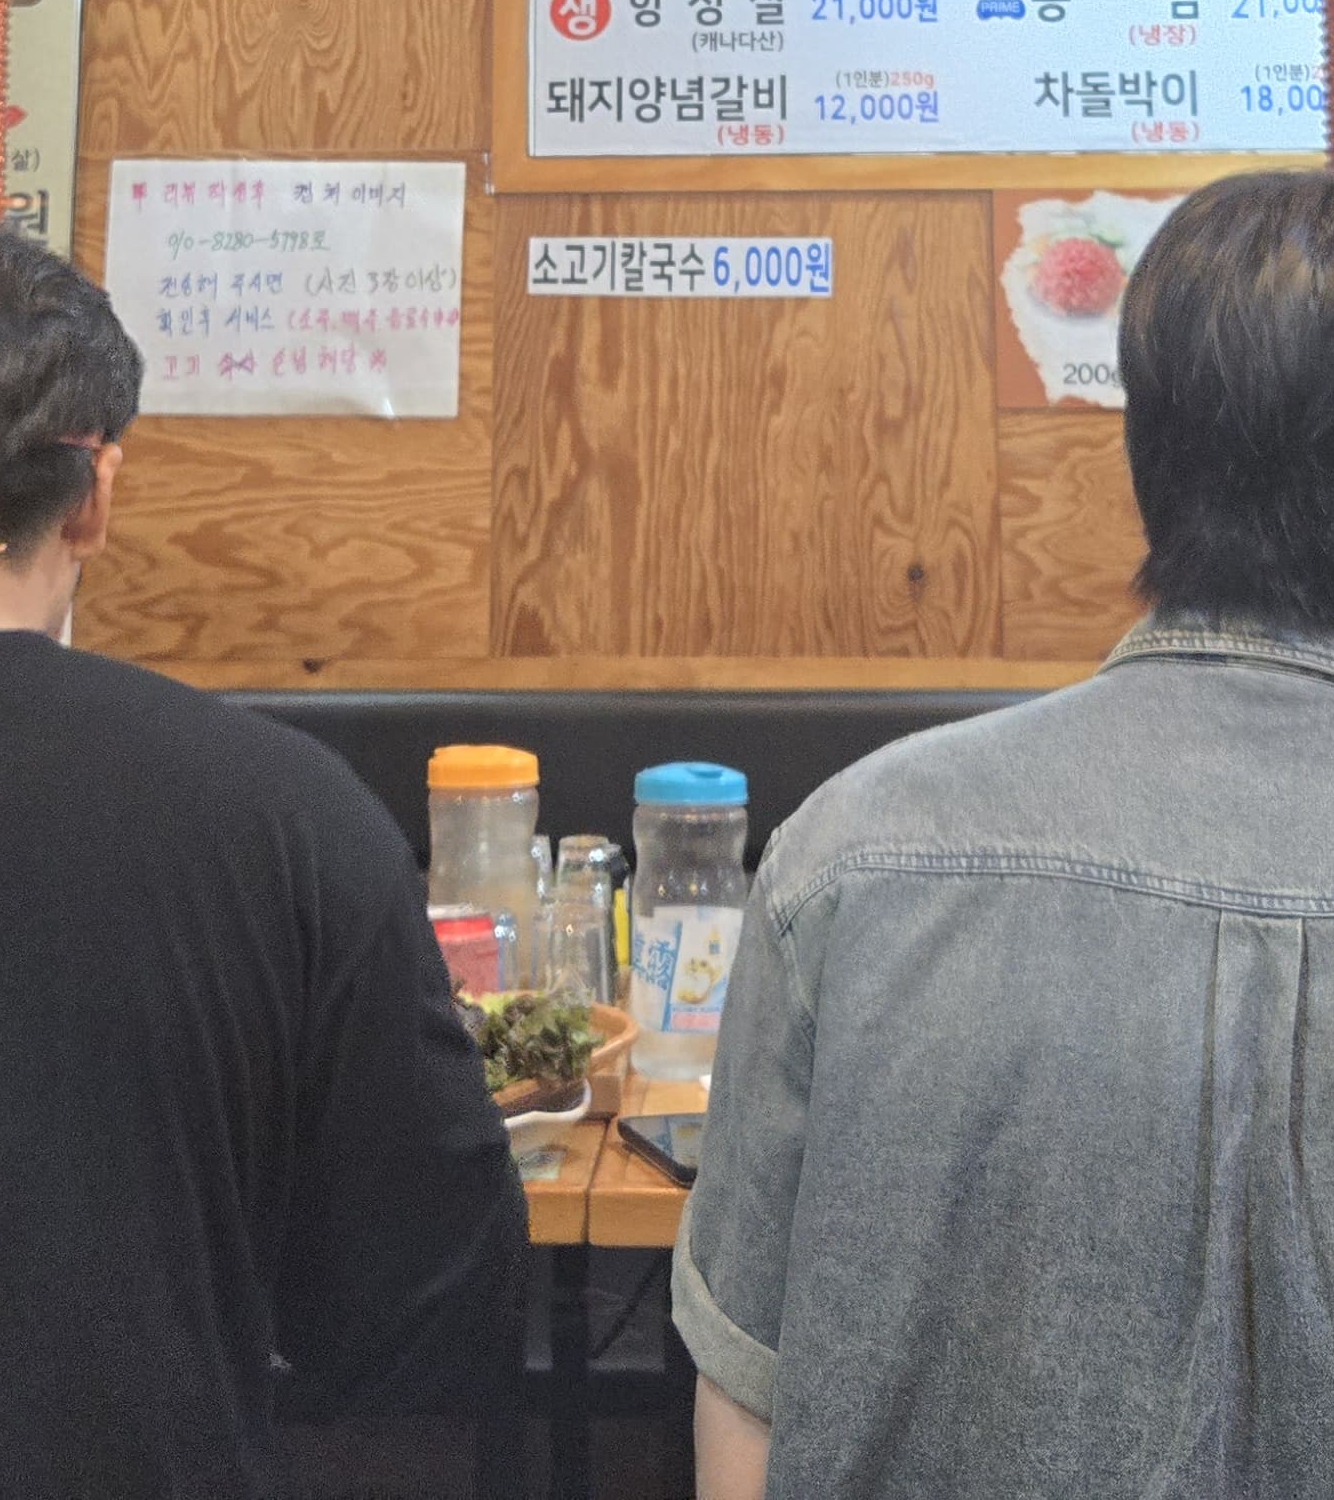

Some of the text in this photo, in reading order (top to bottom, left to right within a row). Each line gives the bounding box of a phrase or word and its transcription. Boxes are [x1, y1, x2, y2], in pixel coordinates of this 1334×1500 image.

[546, 74, 940, 126] 돼지양념갈비 12,000원
[1033, 69, 1327, 118] 차돌박이 18,00
[531, 240, 831, 293] 소고기칼국수 6,000원
